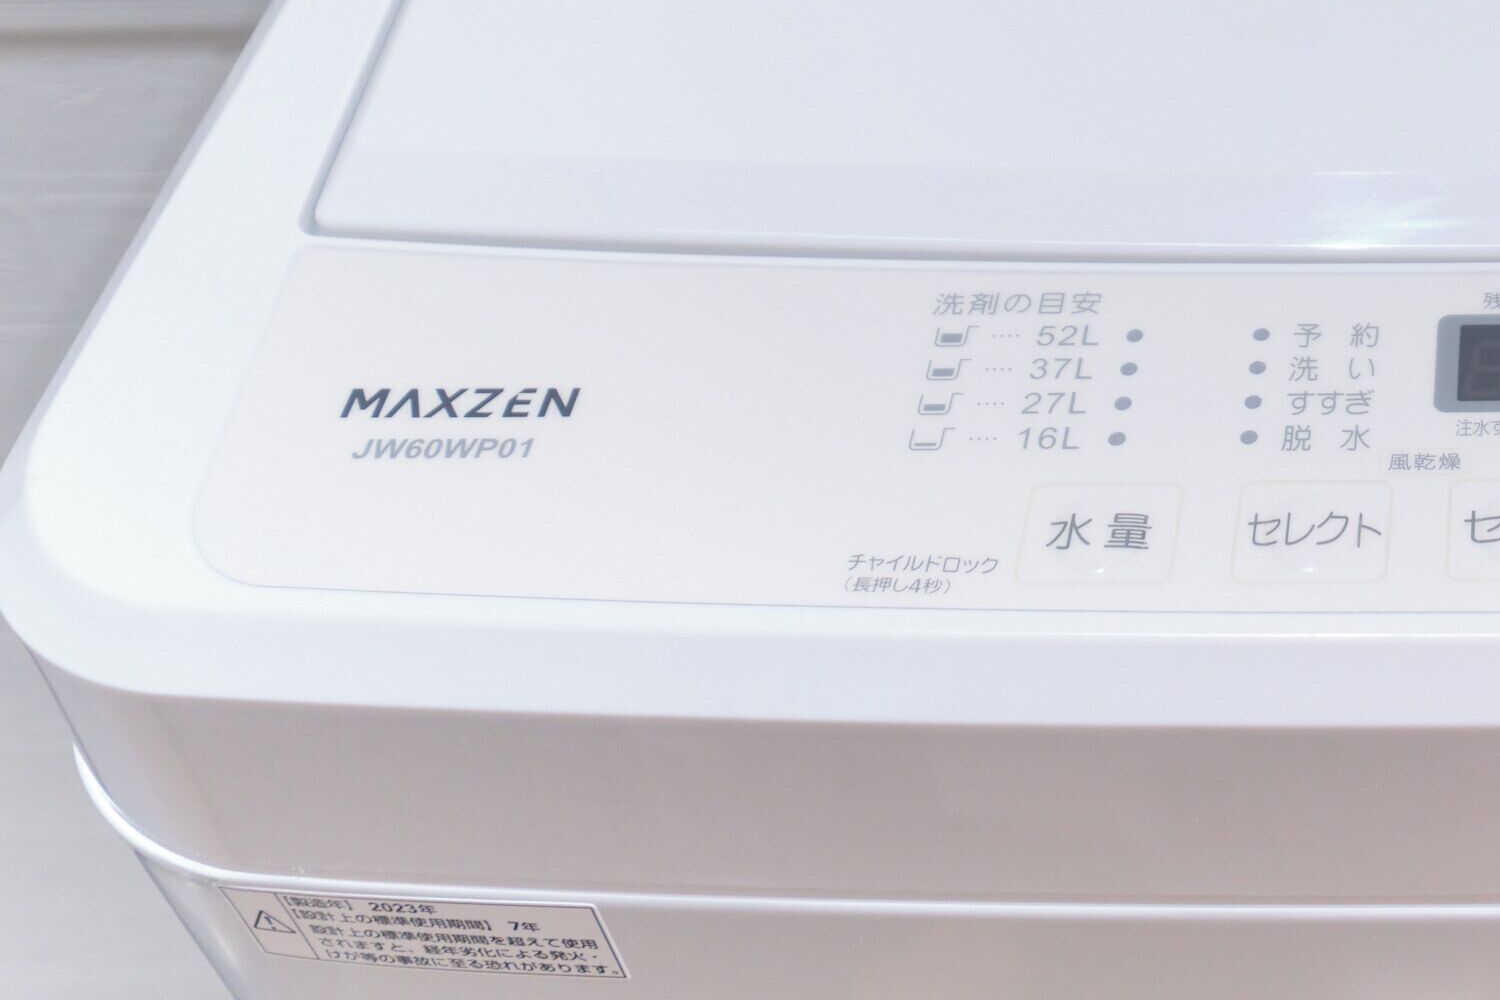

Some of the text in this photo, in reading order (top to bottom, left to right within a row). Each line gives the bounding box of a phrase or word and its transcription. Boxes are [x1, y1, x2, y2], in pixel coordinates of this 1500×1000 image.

[932, 291, 1102, 316] 洗剤の目安
[1036, 324, 1098, 347] 52L
[1029, 357, 1092, 380] 37L
[340, 388, 580, 418] MAXZEN
[1021, 391, 1086, 415] 27L
[1287, 389, 1374, 416] すすぎ
[351, 438, 534, 459] JW60WP01
[1019, 426, 1079, 450] 16L
[1388, 453, 1461, 471] 風乾燥
[1046, 513, 1152, 550] 水量
[1248, 511, 1382, 548] セレクト
[848, 553, 999, 574] チャイルドロック
[368, 901, 438, 915] 2023年
[507, 920, 541, 933] 7年
